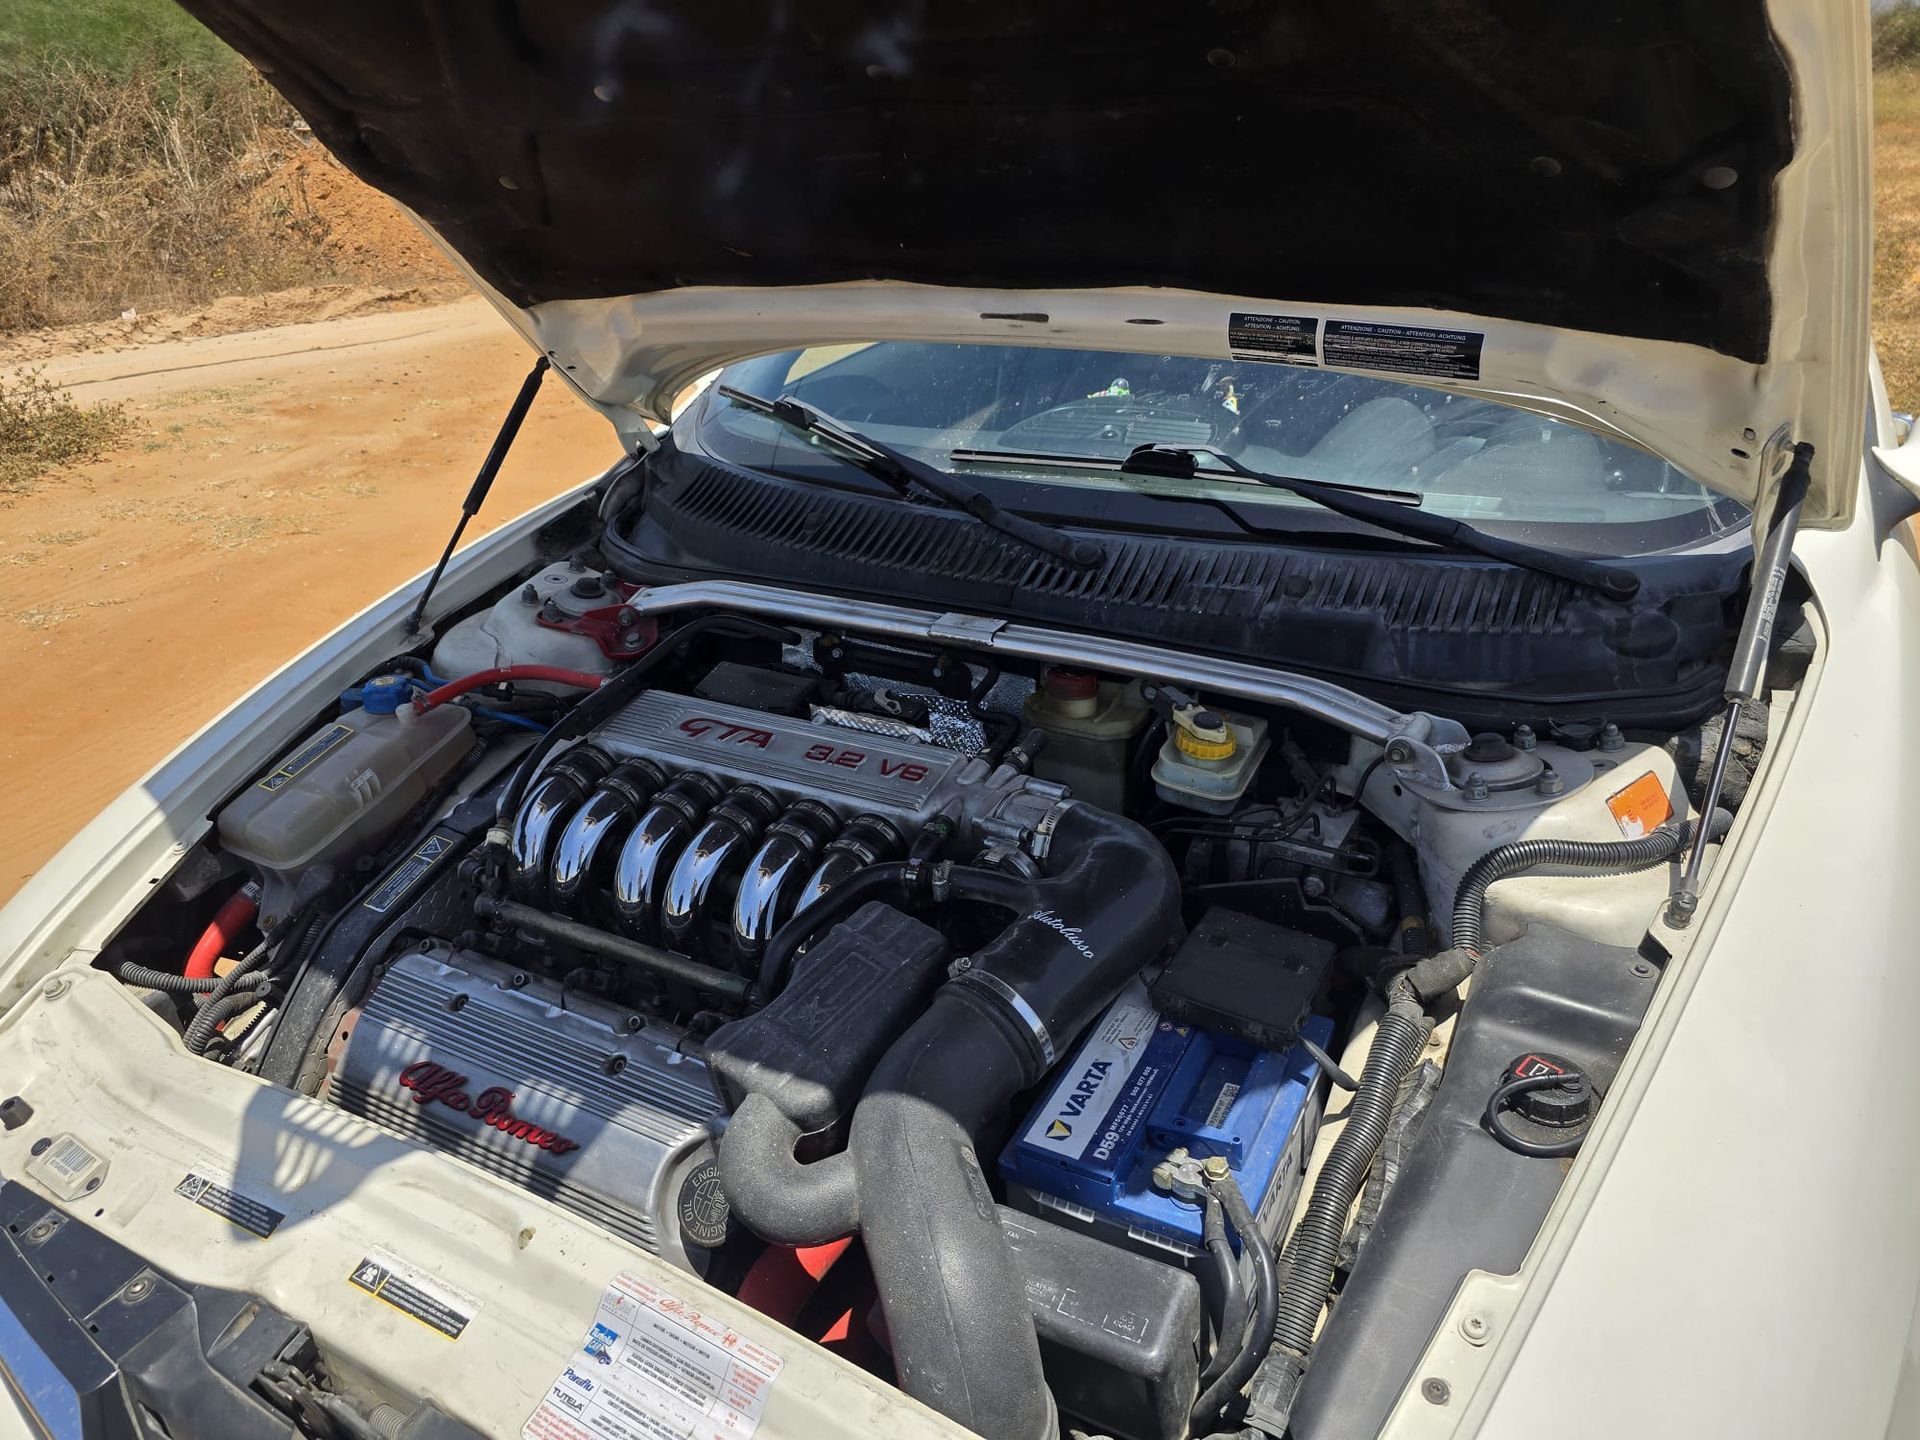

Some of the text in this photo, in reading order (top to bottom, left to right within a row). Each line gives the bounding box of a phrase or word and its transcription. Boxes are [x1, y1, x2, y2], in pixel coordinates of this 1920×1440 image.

[1341, 324, 1466, 341] ATTENZIONE CAUTION ATTENTION ACHTUNG
[679, 717, 930, 784] GTA 3.2 V6
[1027, 910, 1094, 960] Autolusso
[1059, 1061, 1113, 1117] VARTA
[399, 1061, 582, 1155] Alfa Romeo
[1092, 1131, 1120, 1161] D59
[692, 1166, 721, 1187] ENGI
[683, 1200, 695, 1222] OIL
[1006, 1230, 1021, 1240] FAN
[659, 1299, 685, 1318] Alfa
[684, 1311, 720, 1337] Romeo
[562, 1367, 594, 1392] Paraflu
[553, 1387, 584, 1411] TUTELA
